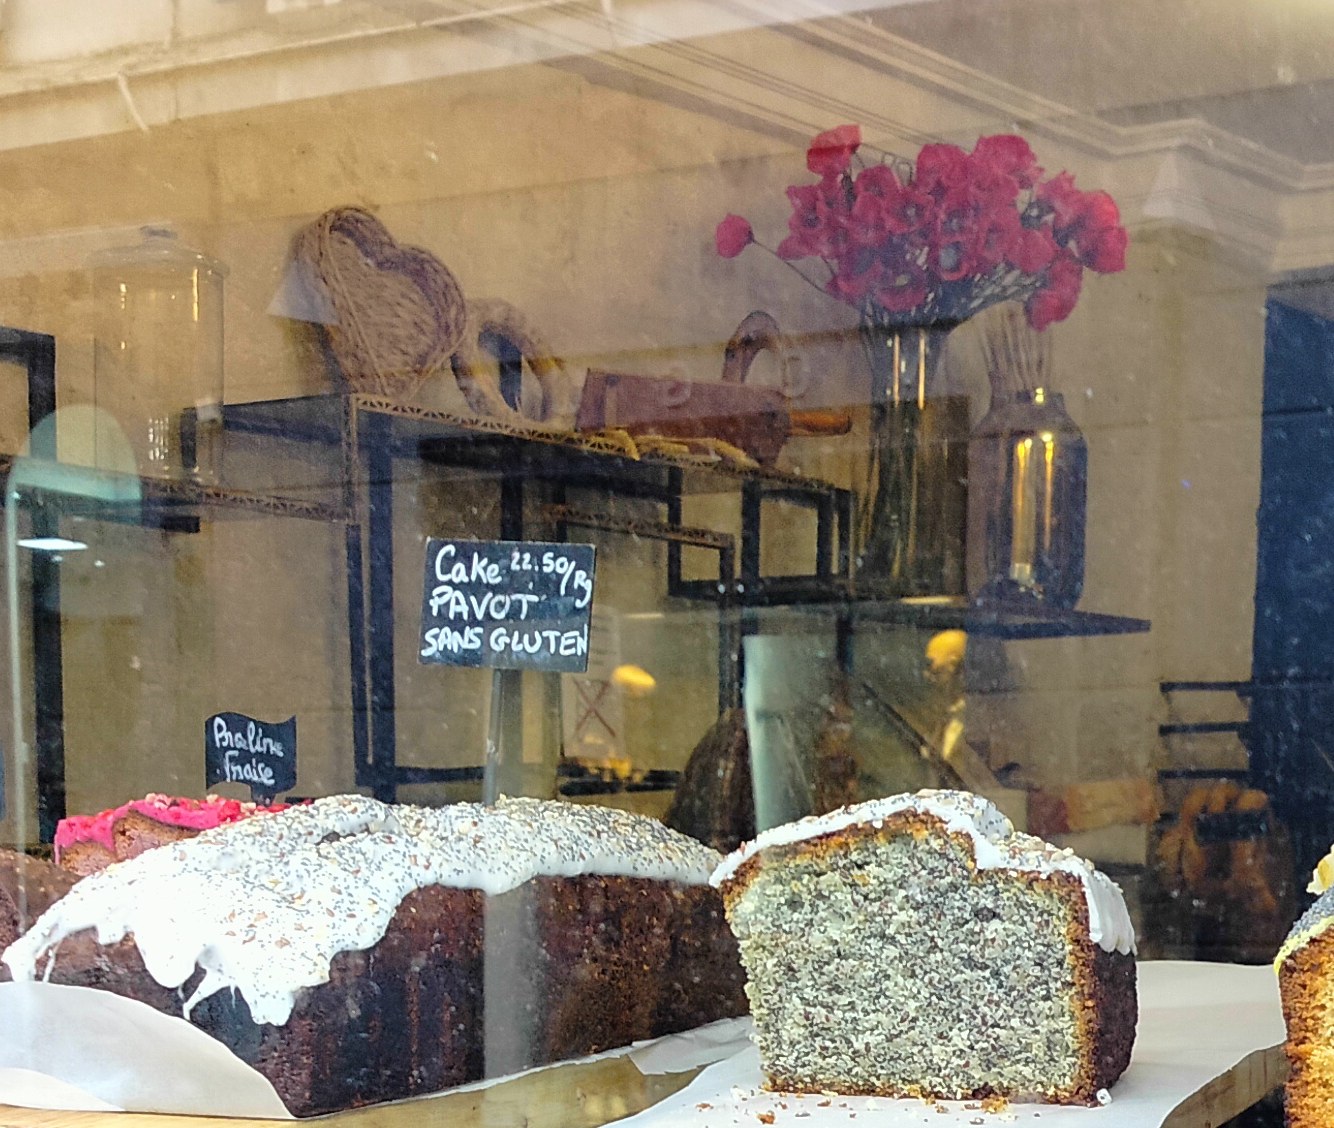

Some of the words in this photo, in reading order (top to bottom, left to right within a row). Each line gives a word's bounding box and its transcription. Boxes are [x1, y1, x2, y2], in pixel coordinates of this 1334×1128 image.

[435, 545, 503, 584] Cake
[429, 585, 540, 620] PAVOT
[421, 626, 483, 656] SANS
[489, 624, 588, 656] GLUTEN
[213, 716, 284, 757] Praline
[224, 750, 275, 785] Fraise
